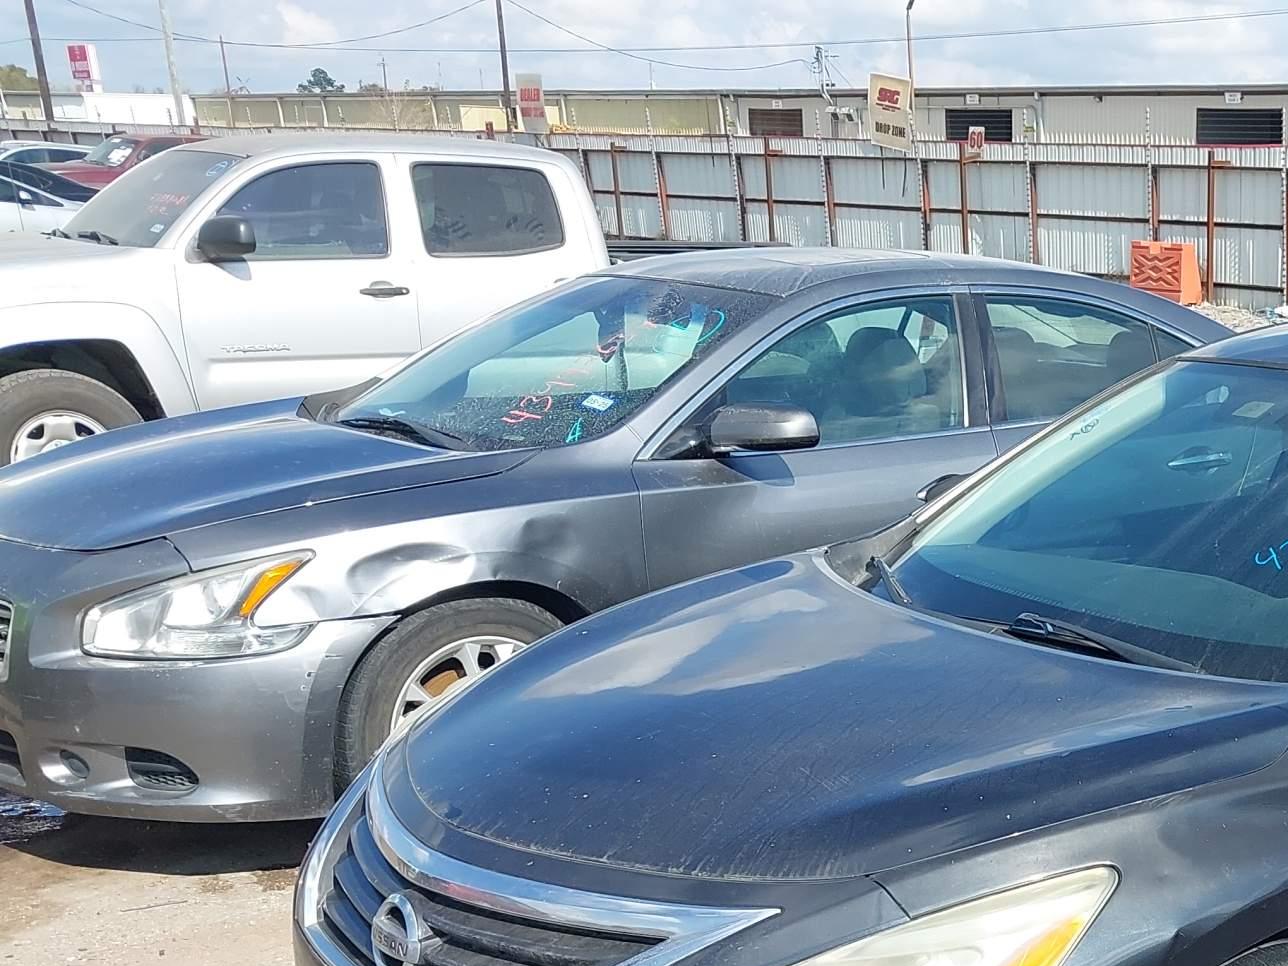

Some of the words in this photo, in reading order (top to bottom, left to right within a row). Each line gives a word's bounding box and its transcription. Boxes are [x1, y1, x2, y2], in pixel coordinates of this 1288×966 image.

[875, 121, 890, 134] DROP
[892, 125, 906, 138] ZONE
[970, 131, 983, 149] 60
[220, 343, 291, 353] TACOMA
